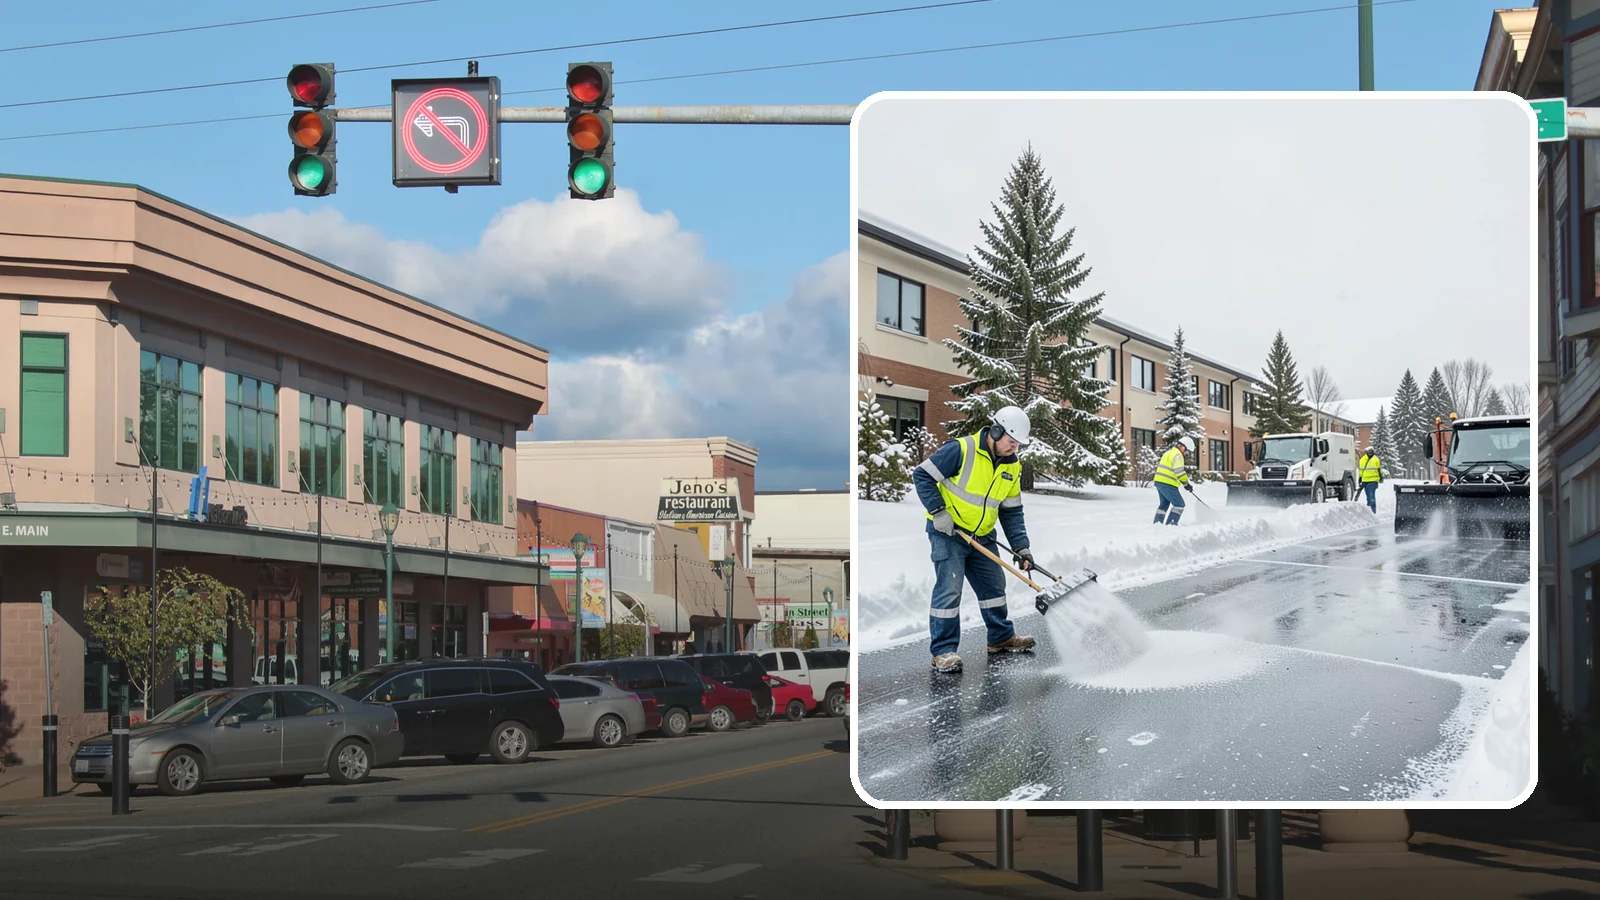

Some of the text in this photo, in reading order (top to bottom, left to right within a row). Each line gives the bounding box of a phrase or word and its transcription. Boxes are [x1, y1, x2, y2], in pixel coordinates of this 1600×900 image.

[670, 480, 727, 494] Jeno's
[665, 496, 731, 509] restaurant
[659, 510, 681, 520] Italian
[686, 509, 714, 519] American
[715, 509, 737, 519] Cuisine
[2, 525, 49, 536] E. MAIN
[786, 607, 796, 616] in
[797, 607, 828, 617] Street
